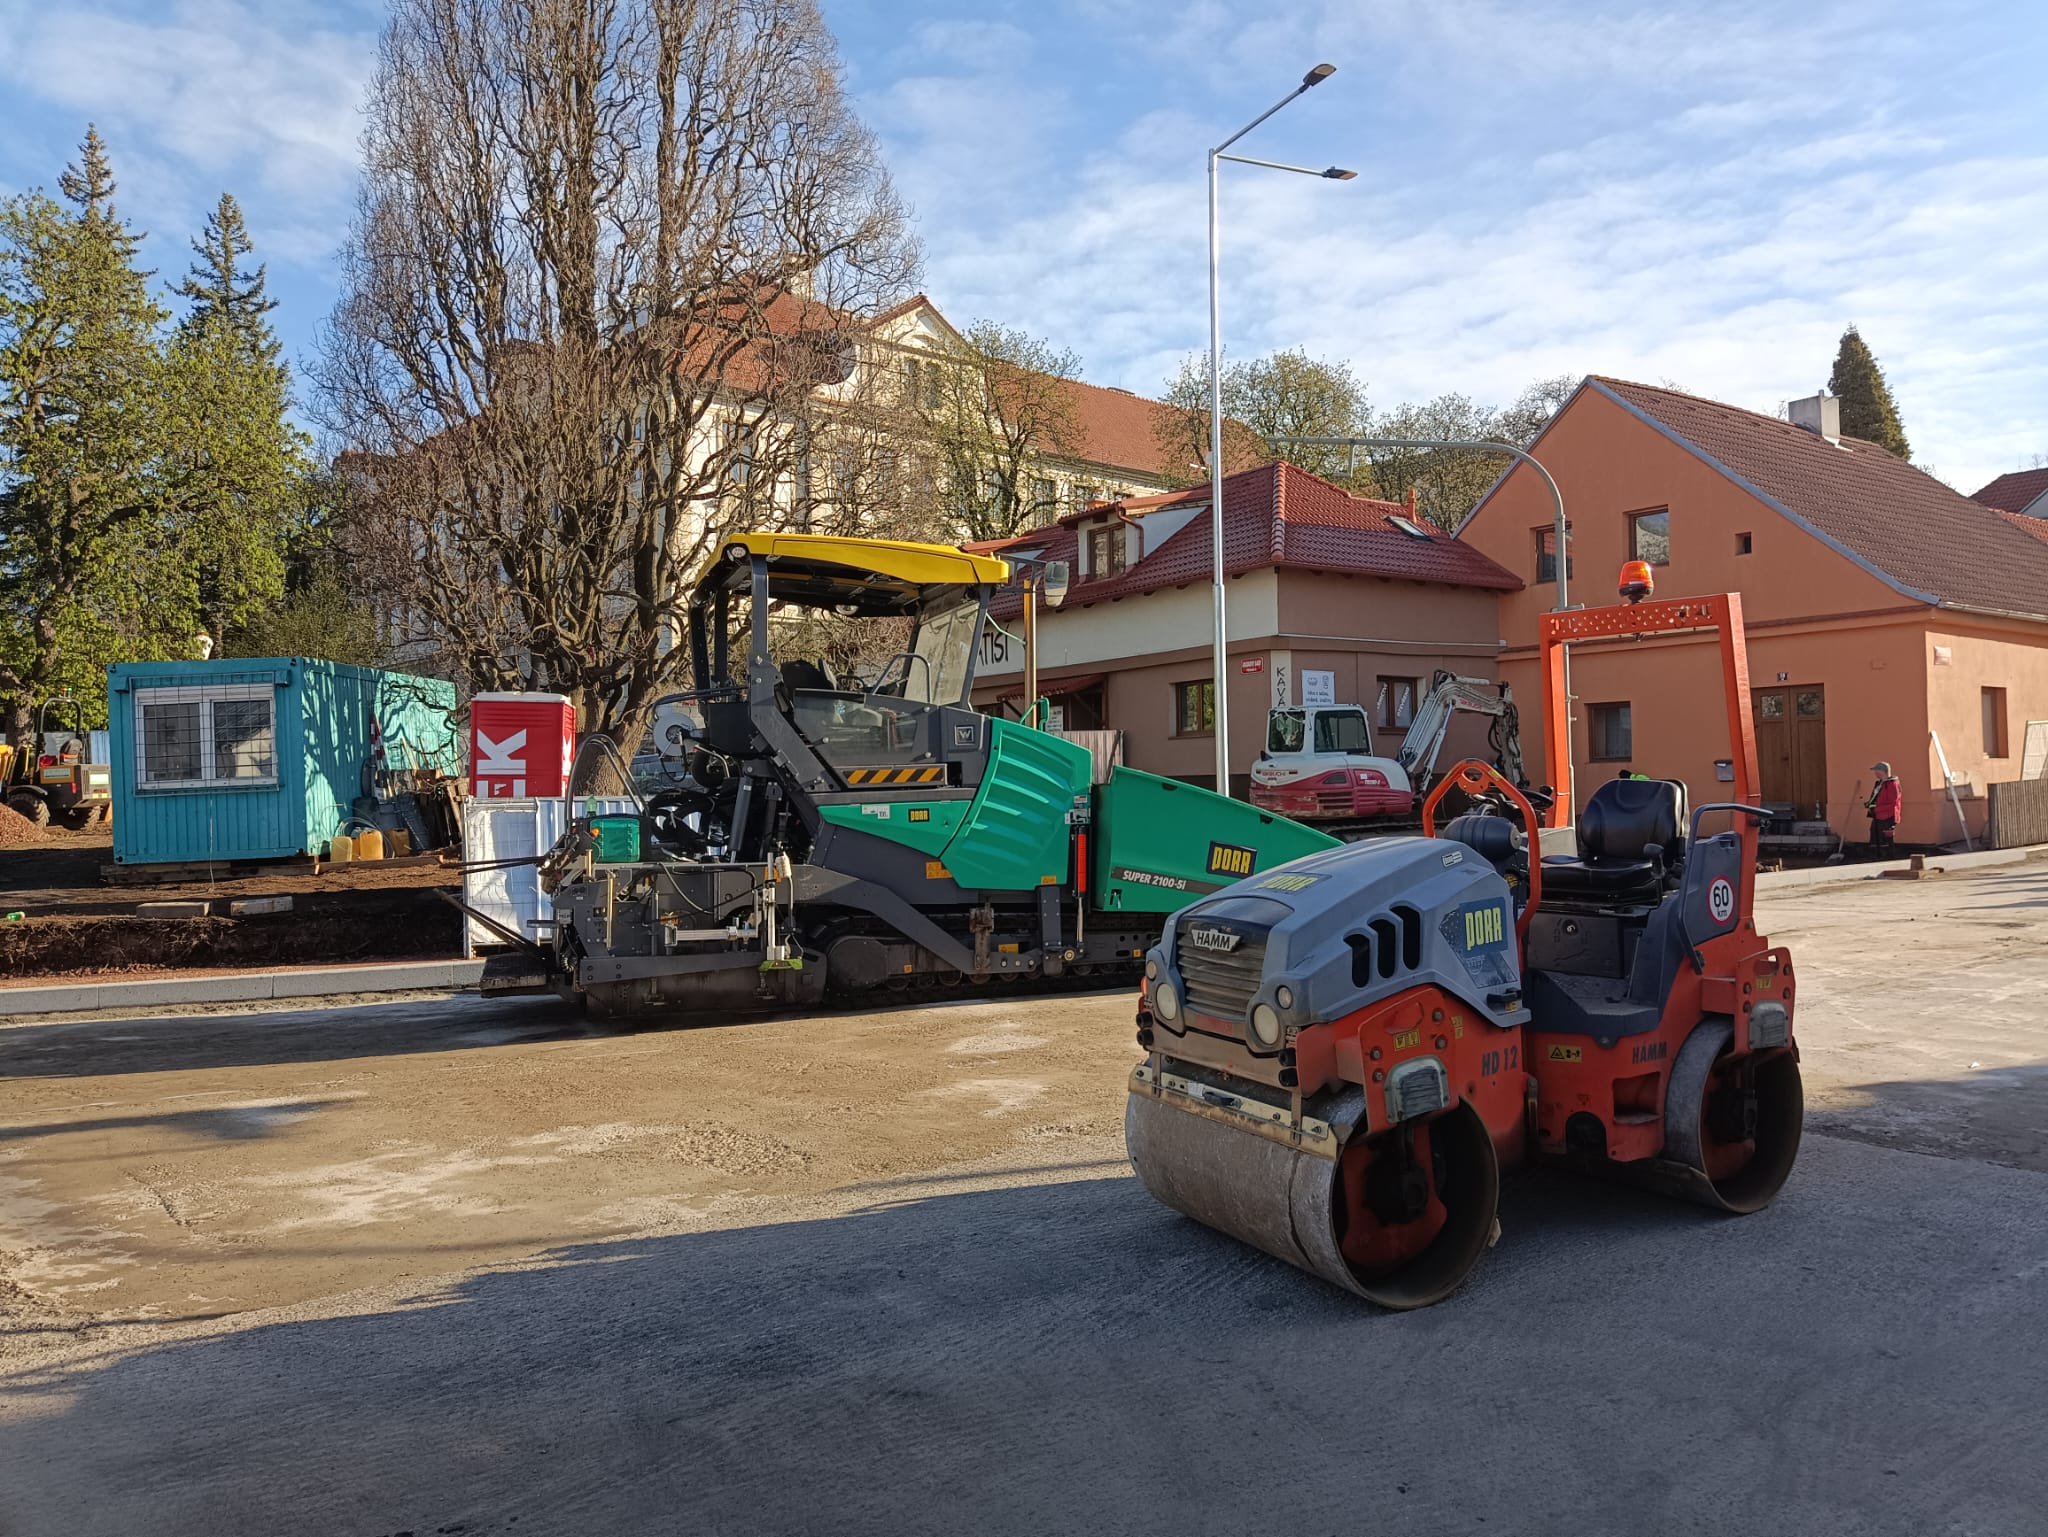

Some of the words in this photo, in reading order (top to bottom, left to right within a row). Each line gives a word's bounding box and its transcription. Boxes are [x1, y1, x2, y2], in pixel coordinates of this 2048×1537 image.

[1212, 846, 1252, 874] PORR
[1122, 870, 1151, 884] SUPER
[1713, 885, 1729, 907] 60
[1465, 907, 1503, 951] PORR
[1196, 931, 1231, 950] HAMM
[1482, 1051, 1500, 1077] HD
[1504, 1046, 1518, 1071] 12
[1632, 1042, 1668, 1064] HAMM
